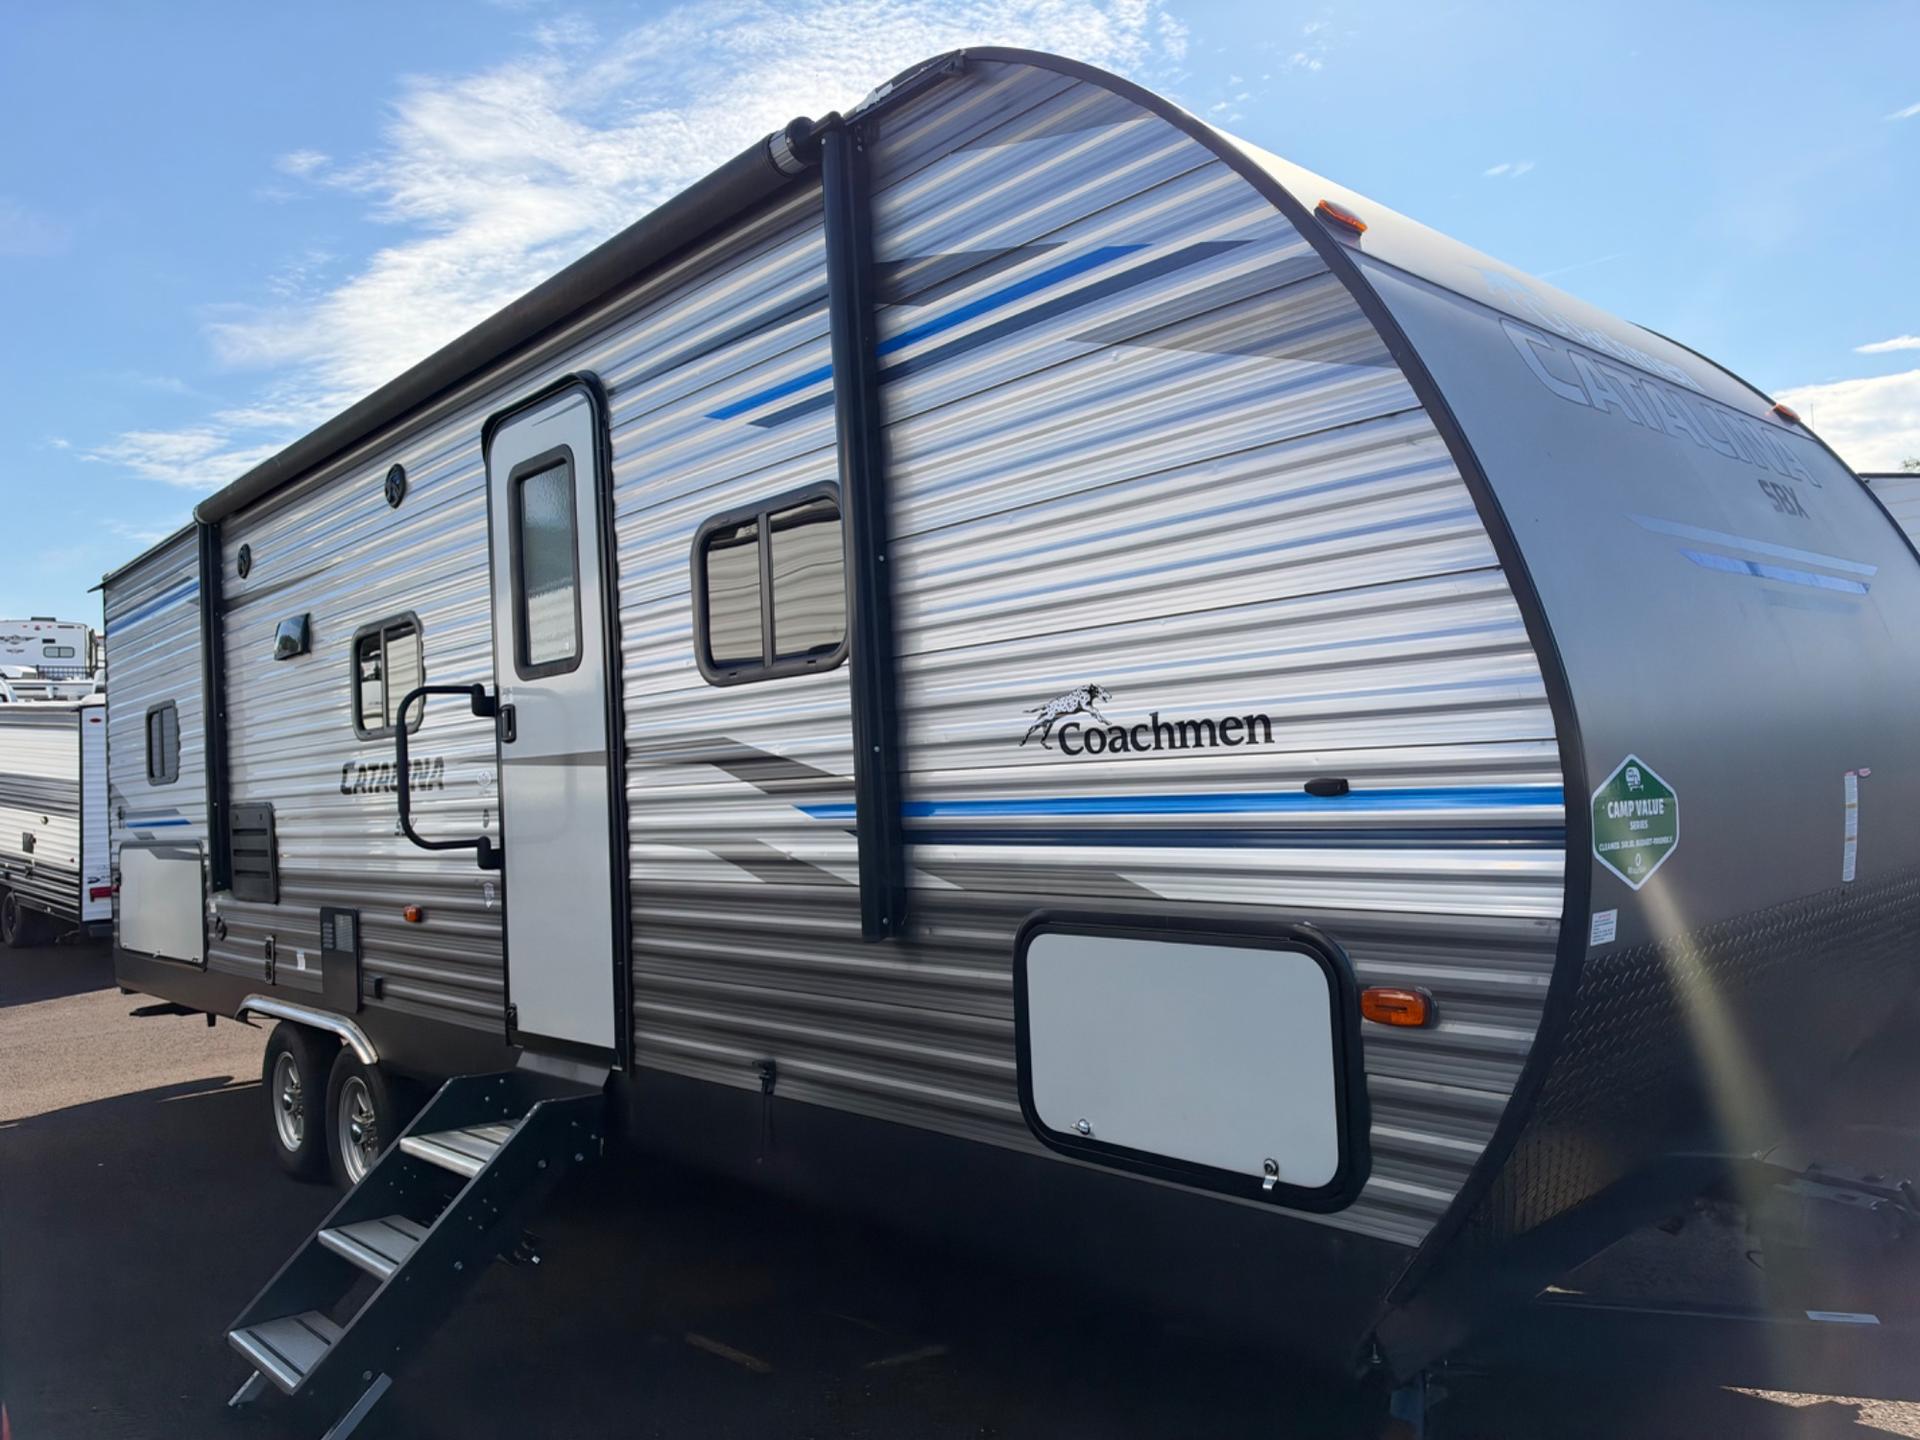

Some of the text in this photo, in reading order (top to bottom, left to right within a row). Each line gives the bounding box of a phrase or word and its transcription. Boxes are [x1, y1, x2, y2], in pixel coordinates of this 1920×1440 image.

[1501, 318, 1823, 488] CATALINA
[1058, 711, 1275, 756] Coachmen
[340, 756, 444, 795] CATALNA
[1607, 798, 1665, 819] CAMP VALUE
[1629, 819, 1649, 830] SERIES
